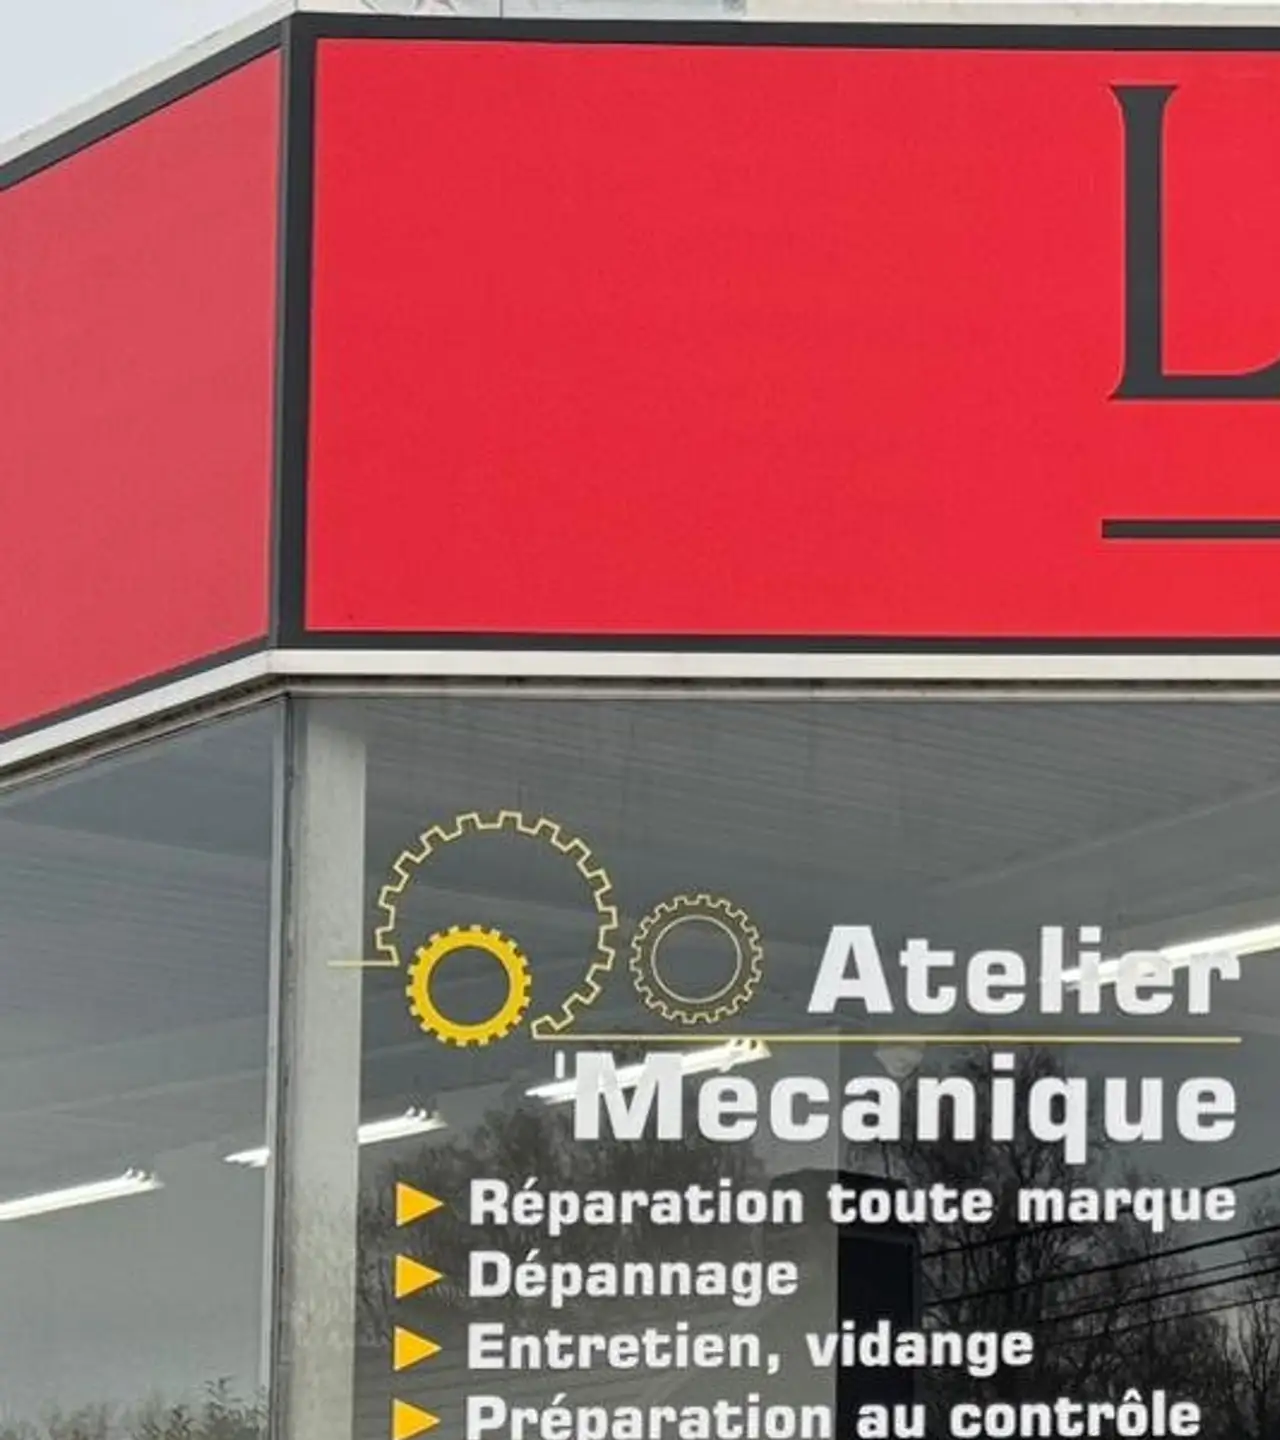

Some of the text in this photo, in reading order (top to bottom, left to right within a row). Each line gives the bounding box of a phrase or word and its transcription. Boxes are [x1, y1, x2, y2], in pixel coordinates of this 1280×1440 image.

[807, 925, 1240, 1015] Atelier
[573, 1047, 1236, 1164] Mécanique
[469, 1177, 1236, 1235] Réparation toute marque
[469, 1250, 799, 1304] Dépannage
[467, 1320, 1034, 1377] Entretien, vidange
[856, 1404, 926, 1439] au
[950, 1390, 1200, 1438] contrôle
